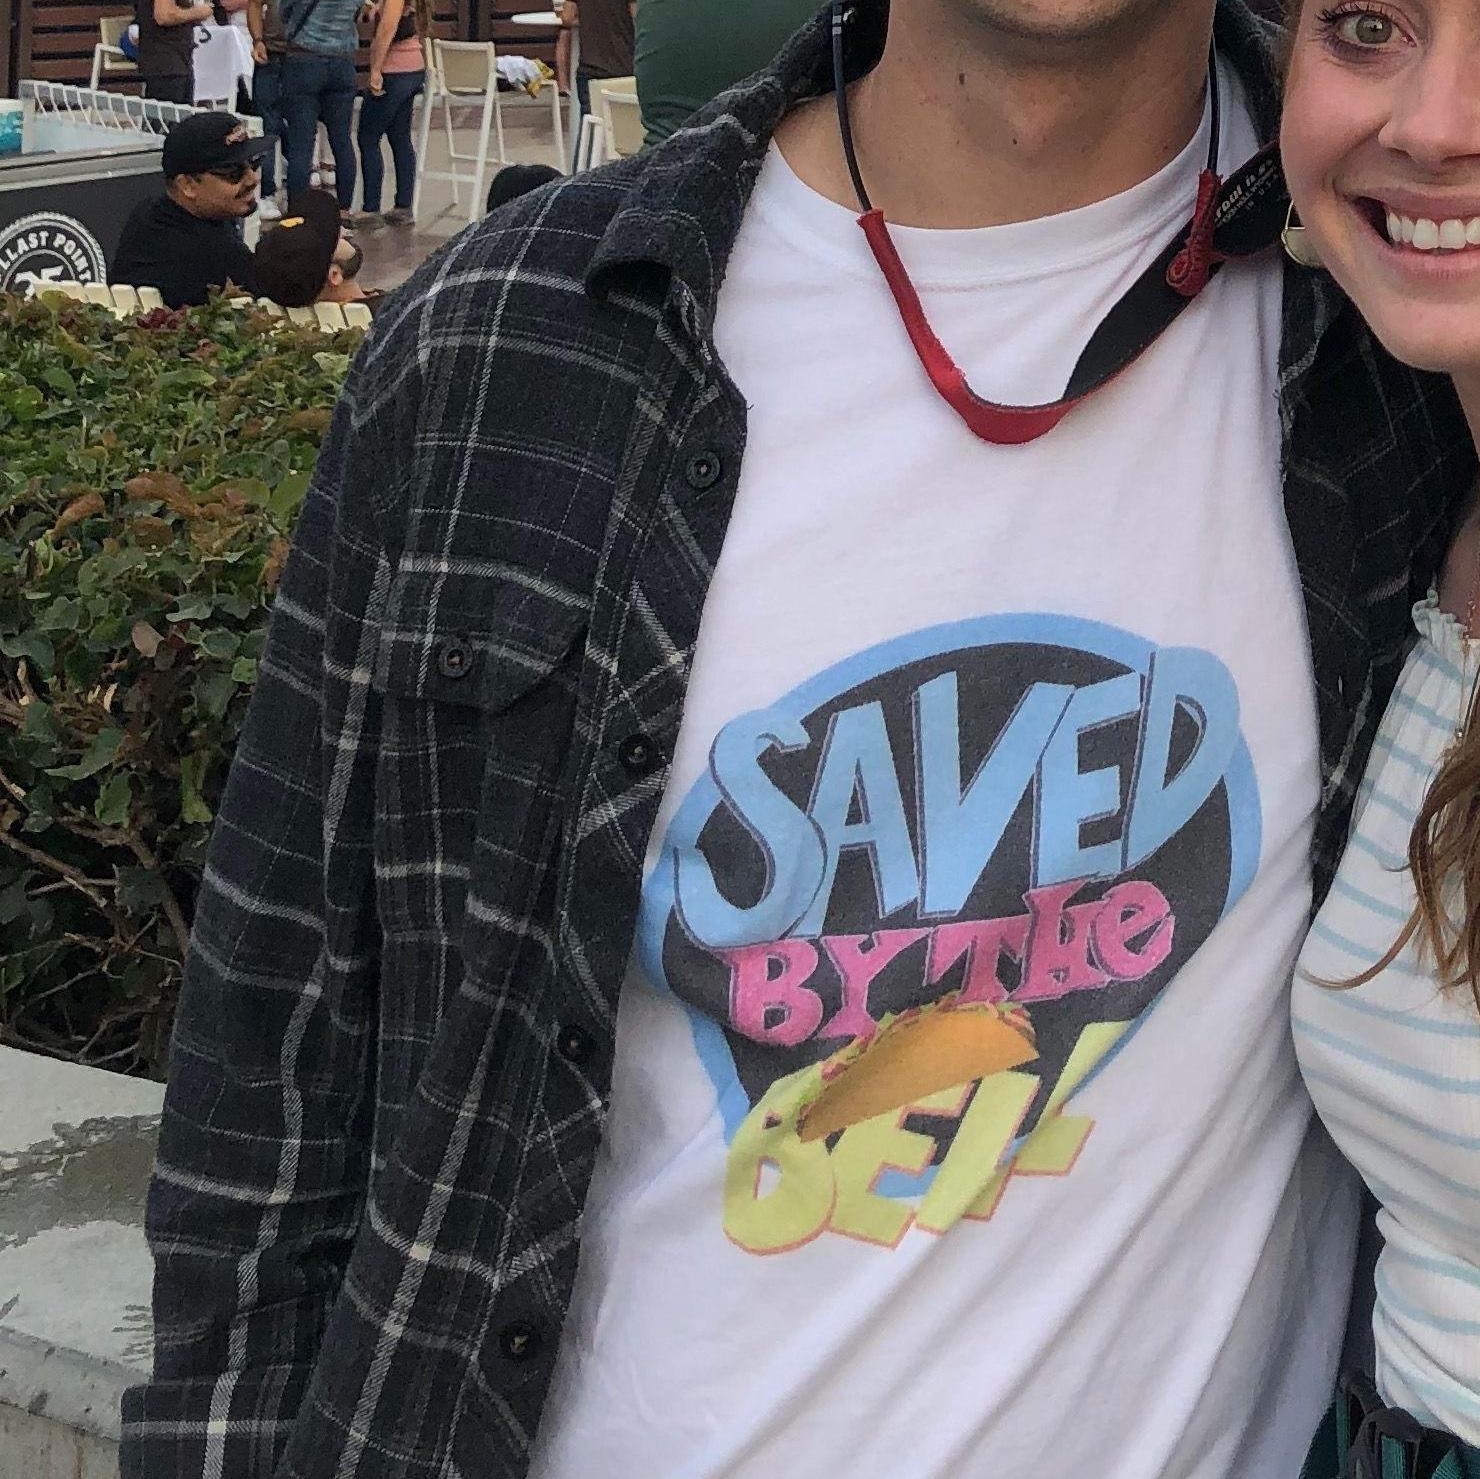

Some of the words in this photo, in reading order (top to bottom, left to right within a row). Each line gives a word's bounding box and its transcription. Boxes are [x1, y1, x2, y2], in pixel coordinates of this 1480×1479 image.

[0, 230, 49, 270] LLAST
[53, 232, 92, 280] POINT
[673, 646, 1239, 950] SAVED
[727, 926, 934, 1047] BY
